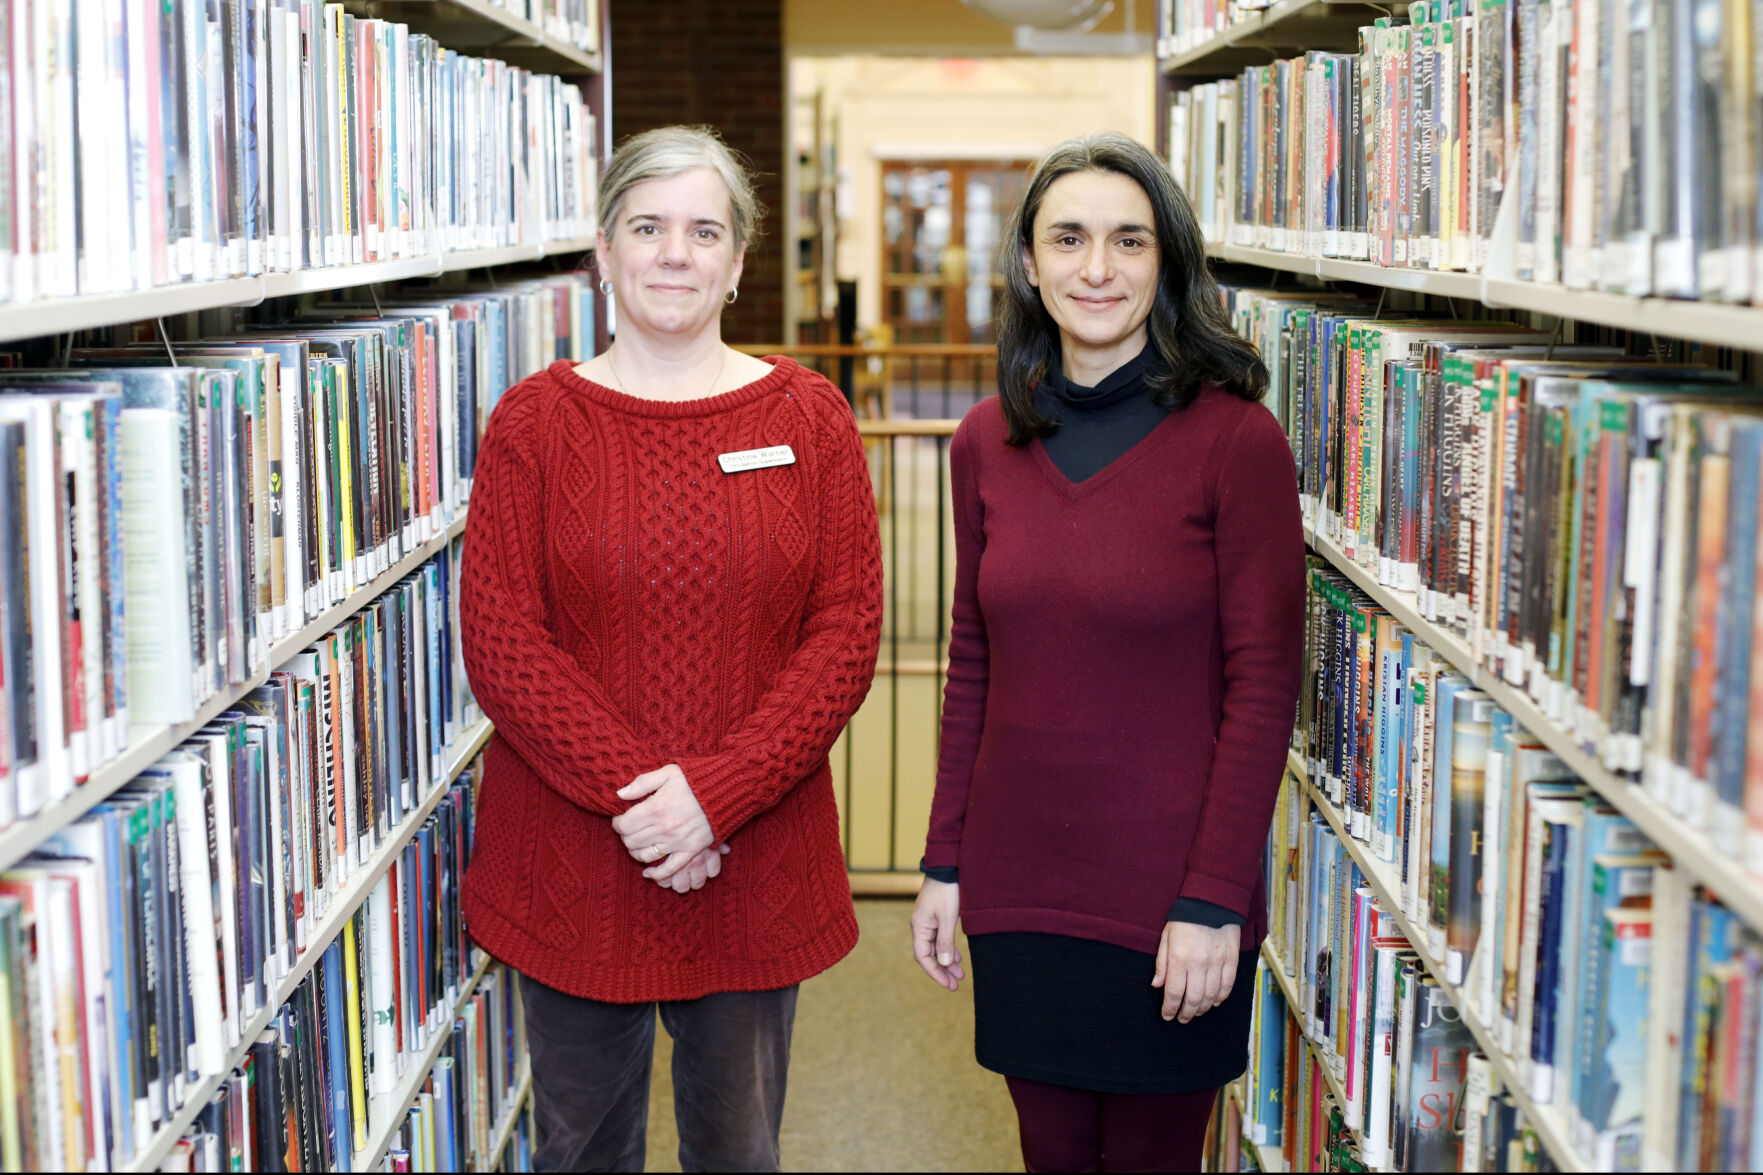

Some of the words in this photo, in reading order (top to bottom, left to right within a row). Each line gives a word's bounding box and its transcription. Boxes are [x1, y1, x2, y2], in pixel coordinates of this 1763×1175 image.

[1352, 95, 1360, 135] TIGERS
[1421, 109, 1432, 163] POISONED
[1399, 137, 1407, 205] MAGGODY
[1420, 166, 1431, 192] PINS
[1296, 351, 1304, 379] THE
[1370, 379, 1379, 428] HIAASEN
[1444, 382, 1454, 408] CK
[1295, 384, 1304, 467] TREATMENT
[1362, 406, 1372, 448] TIGHT
[1452, 403, 1463, 467] HIGGINS
[1362, 467, 1371, 492] CARL
[1369, 446, 1377, 489] SKINNY
[1441, 413, 1454, 497] HIGGINS
[1502, 418, 1518, 488] STANDOFF
[1347, 472, 1356, 528] HIAASEN
[1361, 494, 1371, 536] HIAASEN
[1336, 609, 1344, 626] CK
[1317, 633, 1326, 701] HIGGINS
[1334, 628, 1343, 683] HIGGINS
[343, 651, 352, 719] OONTZ
[361, 754, 369, 800] ashley
[207, 803, 217, 860] PARIS
[319, 967, 327, 1044] KOONTZ
